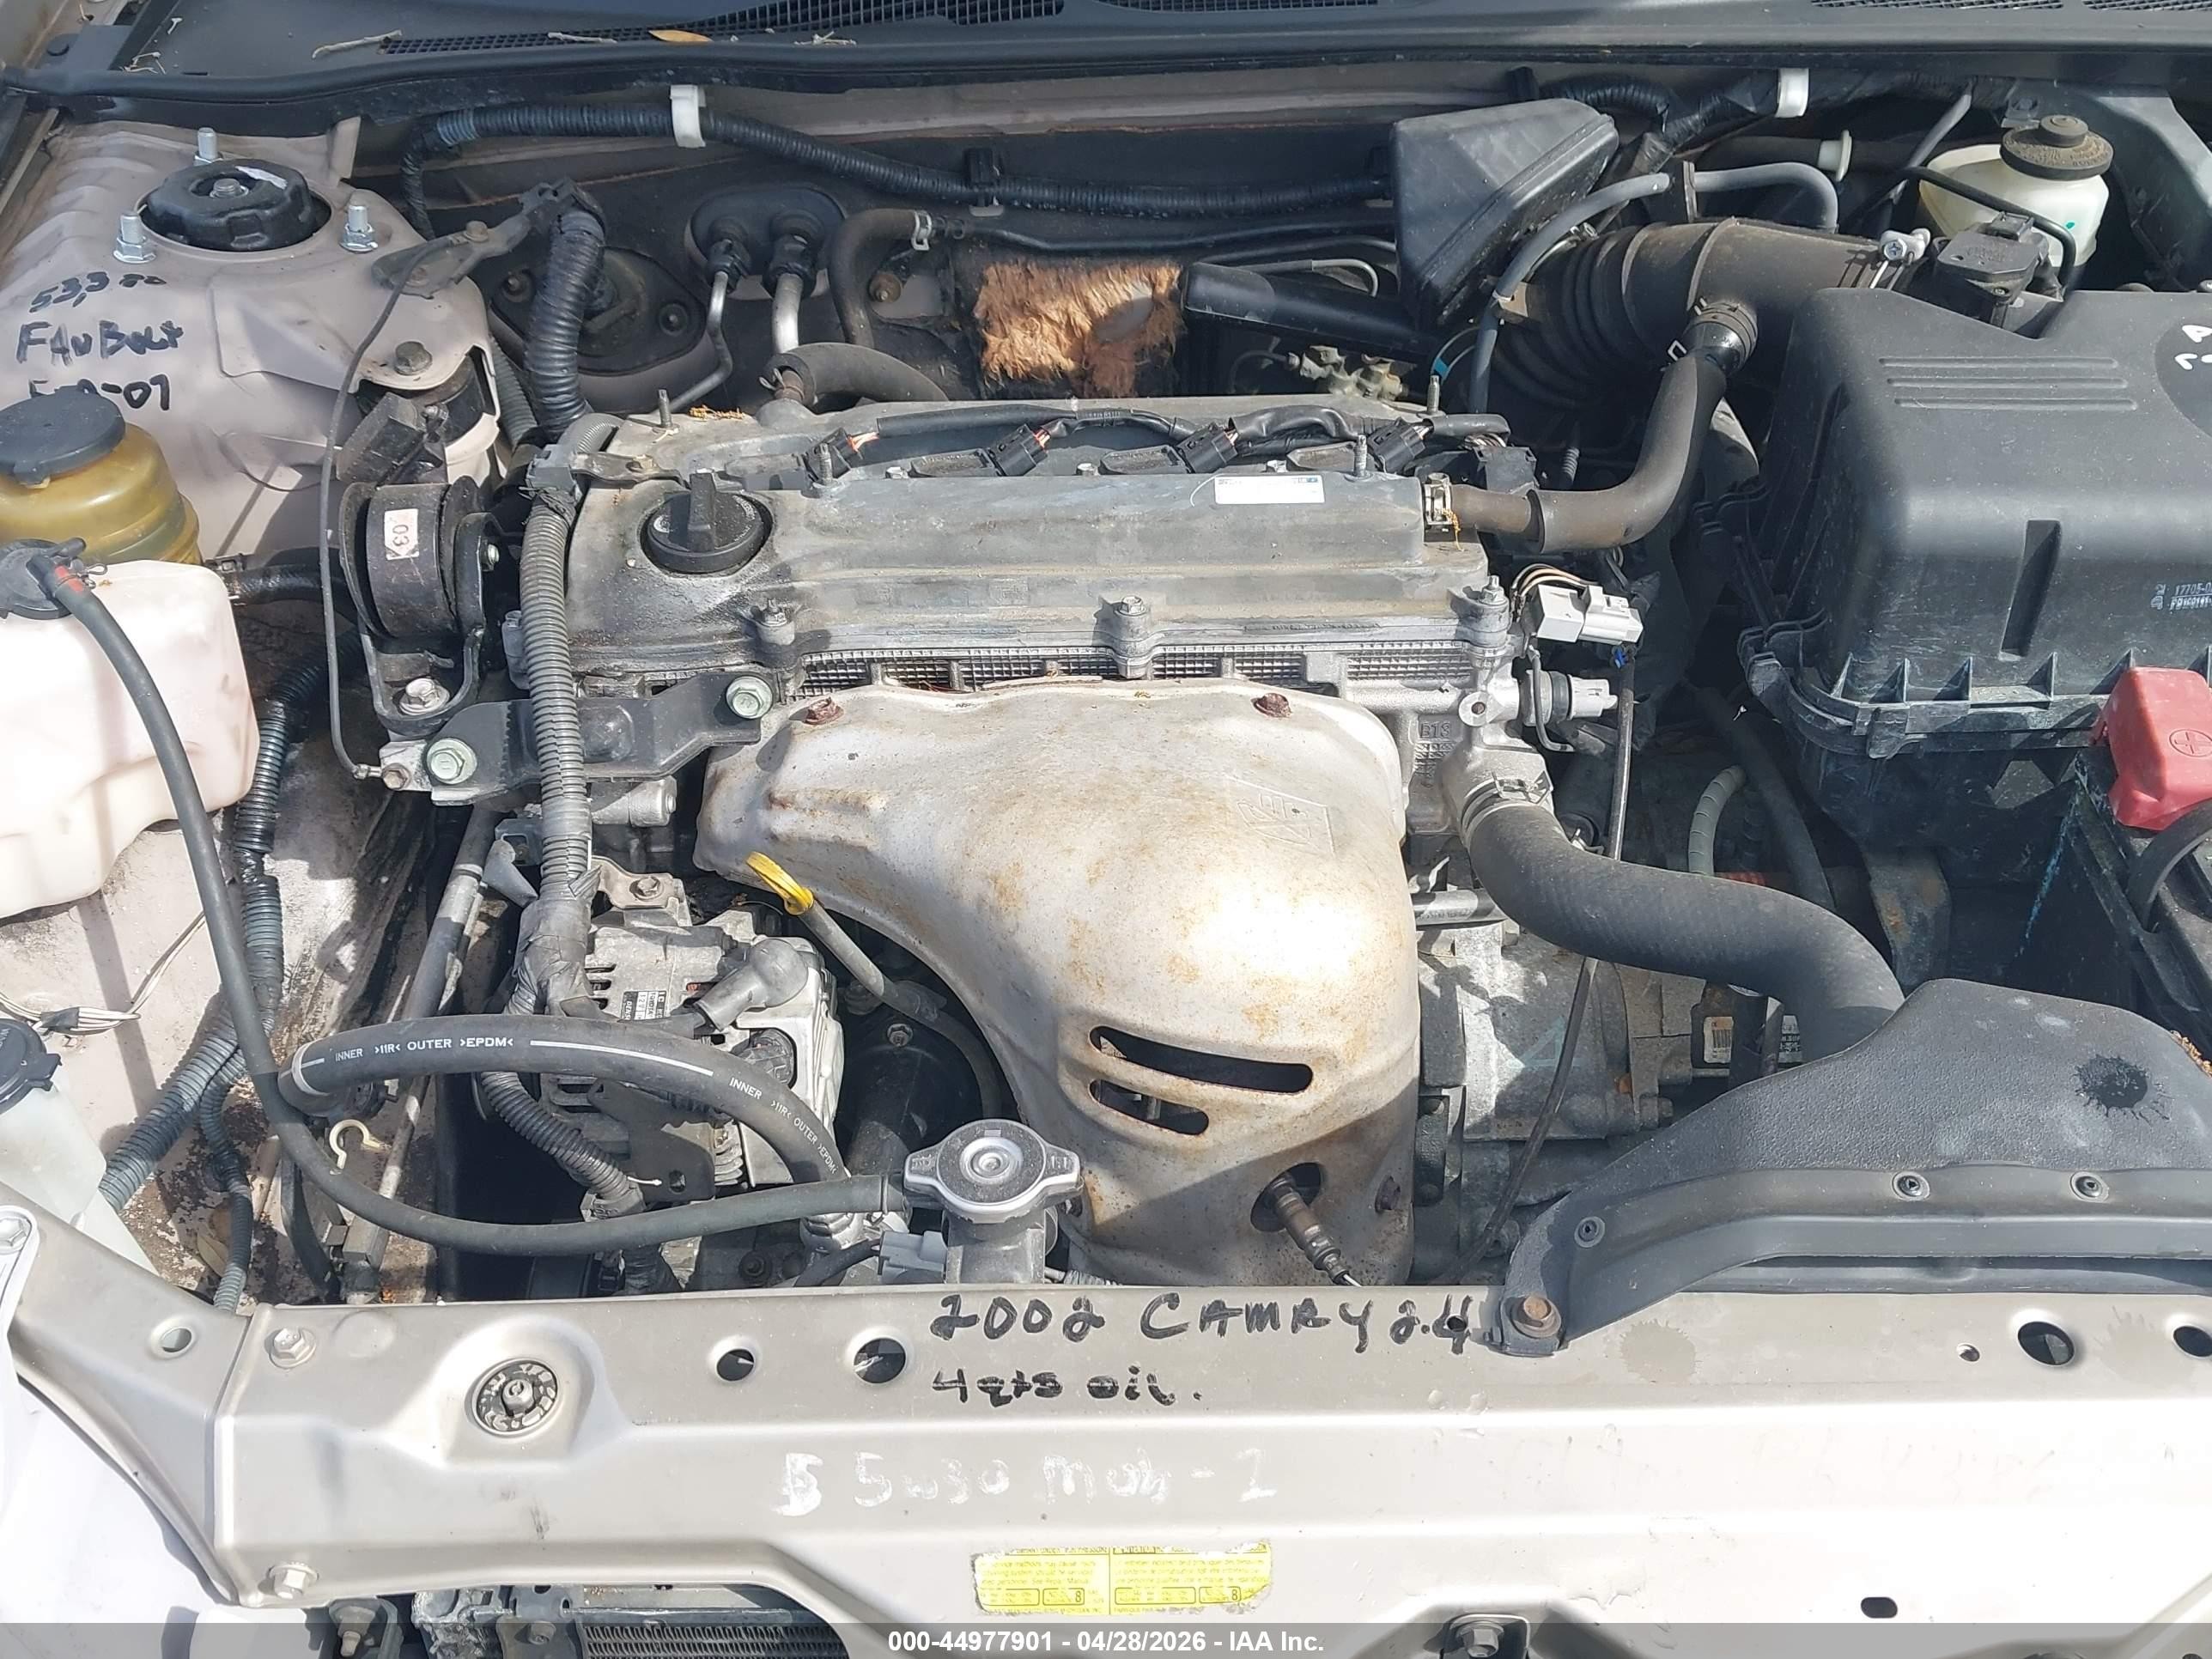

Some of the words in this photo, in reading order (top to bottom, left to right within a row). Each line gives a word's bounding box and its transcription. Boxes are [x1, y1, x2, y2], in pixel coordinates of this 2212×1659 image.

[335, 1048, 363, 1062] INNER
[407, 1038, 453, 1051] OUTER
[728, 1077, 763, 1100] INNER
[793, 1117, 818, 1144] OUTER
[930, 1294, 1106, 1343] 2002
[1139, 1291, 1374, 1355] CAMRY
[1075, 1590, 1082, 1603] 8
[1231, 1589, 1239, 1601] 8
